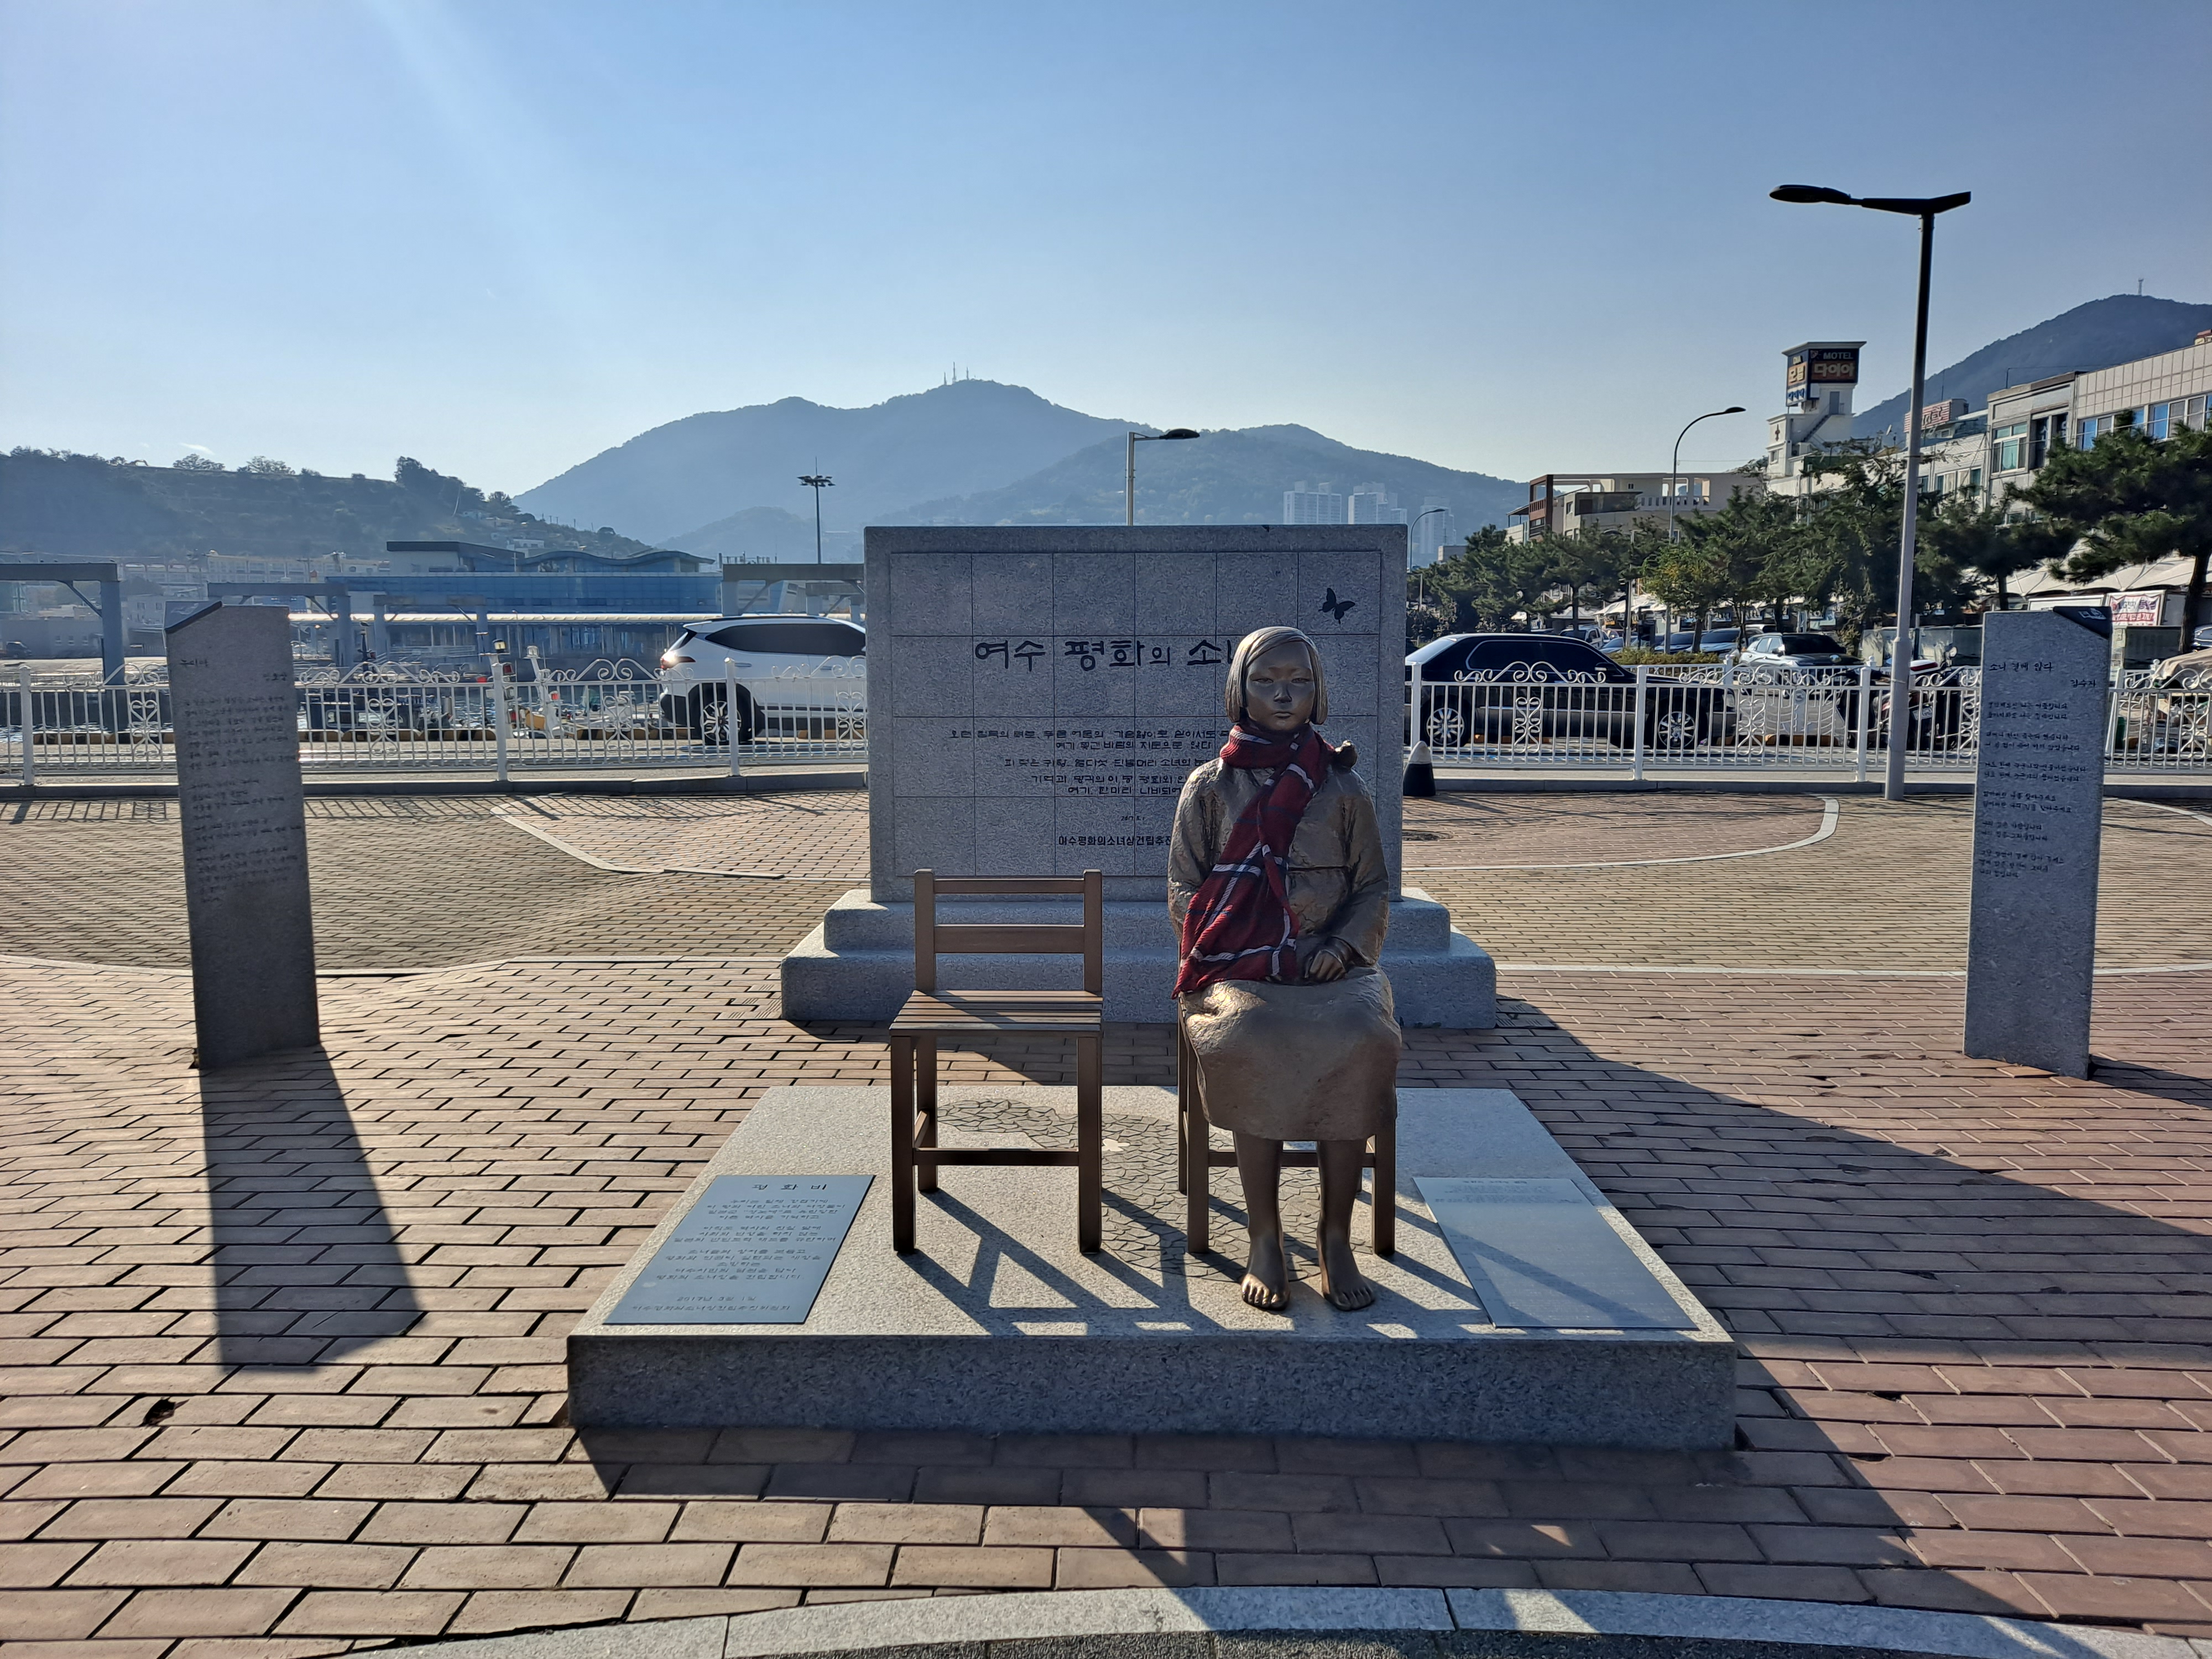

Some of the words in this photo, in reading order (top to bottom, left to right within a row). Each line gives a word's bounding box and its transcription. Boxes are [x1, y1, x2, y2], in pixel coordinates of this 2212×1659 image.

[1814, 363, 1855, 377] 다이아
[975, 640, 1046, 672] 여수
[1065, 640, 1171, 671] 평화의
[1056, 742, 1074, 750] 여기
[1104, 741, 1134, 750] 바람의
[1160, 758, 1191, 767] 소녀의
[1032, 775, 1067, 784] 기억과
